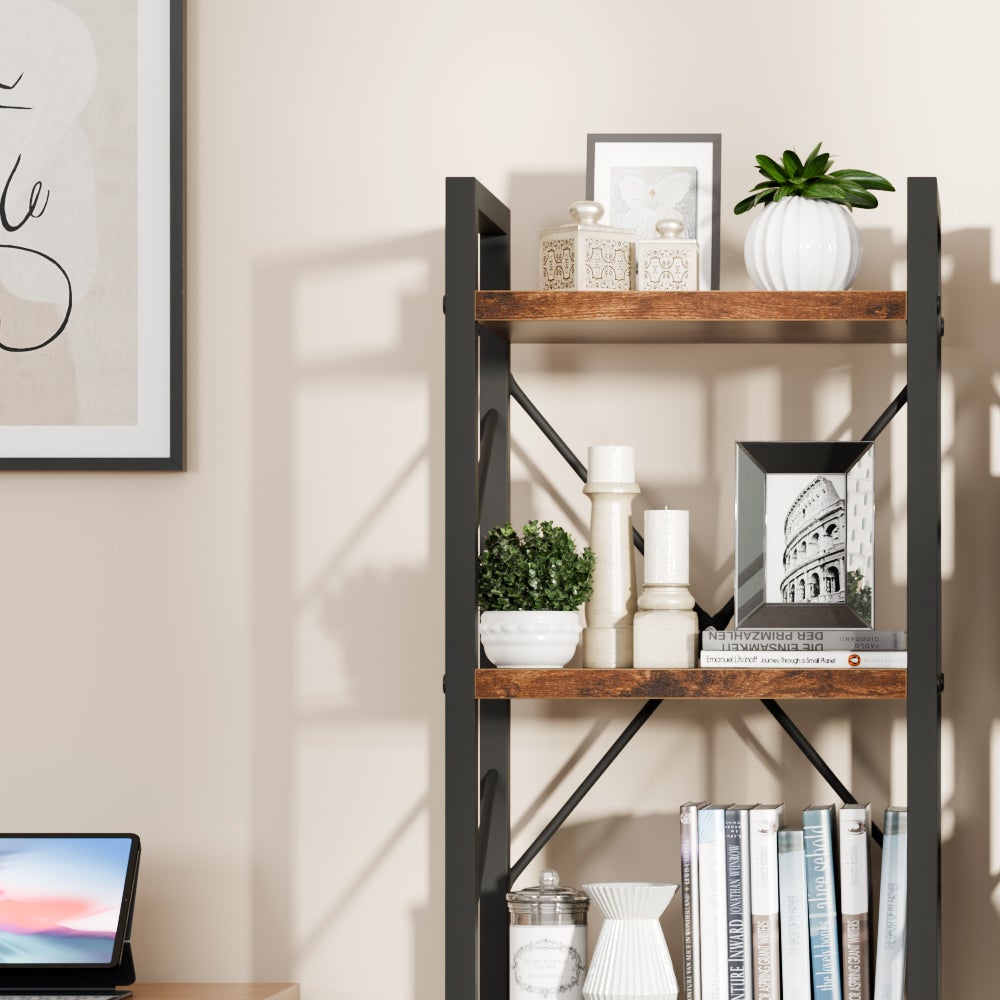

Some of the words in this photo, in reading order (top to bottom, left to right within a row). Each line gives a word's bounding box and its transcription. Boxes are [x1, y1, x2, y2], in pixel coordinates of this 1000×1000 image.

[708, 631, 793, 641] PRIMZAHLEN
[722, 643, 802, 651] EINSAMKEIT
[798, 632, 824, 641] DER
[806, 643, 824, 651] DIE
[707, 655, 734, 664] Emanuel
[760, 657, 780, 666] Journey
[780, 656, 800, 666] Through
[806, 656, 820, 664] Small
[820, 656, 837, 664] Planet
[804, 825, 828, 872] sebold
[728, 879, 742, 915] JONATHAN
[808, 876, 829, 909] alice
[684, 894, 692, 936] WONDERLAND
[727, 918, 745, 962] INWARD
[812, 920, 830, 948] bones
[847, 920, 860, 943] WRITERS
[813, 948, 833, 976] lovely
[848, 944, 861, 965] GRANT
[816, 975, 834, 991] the
[848, 965, 861, 991] ASPIRING
